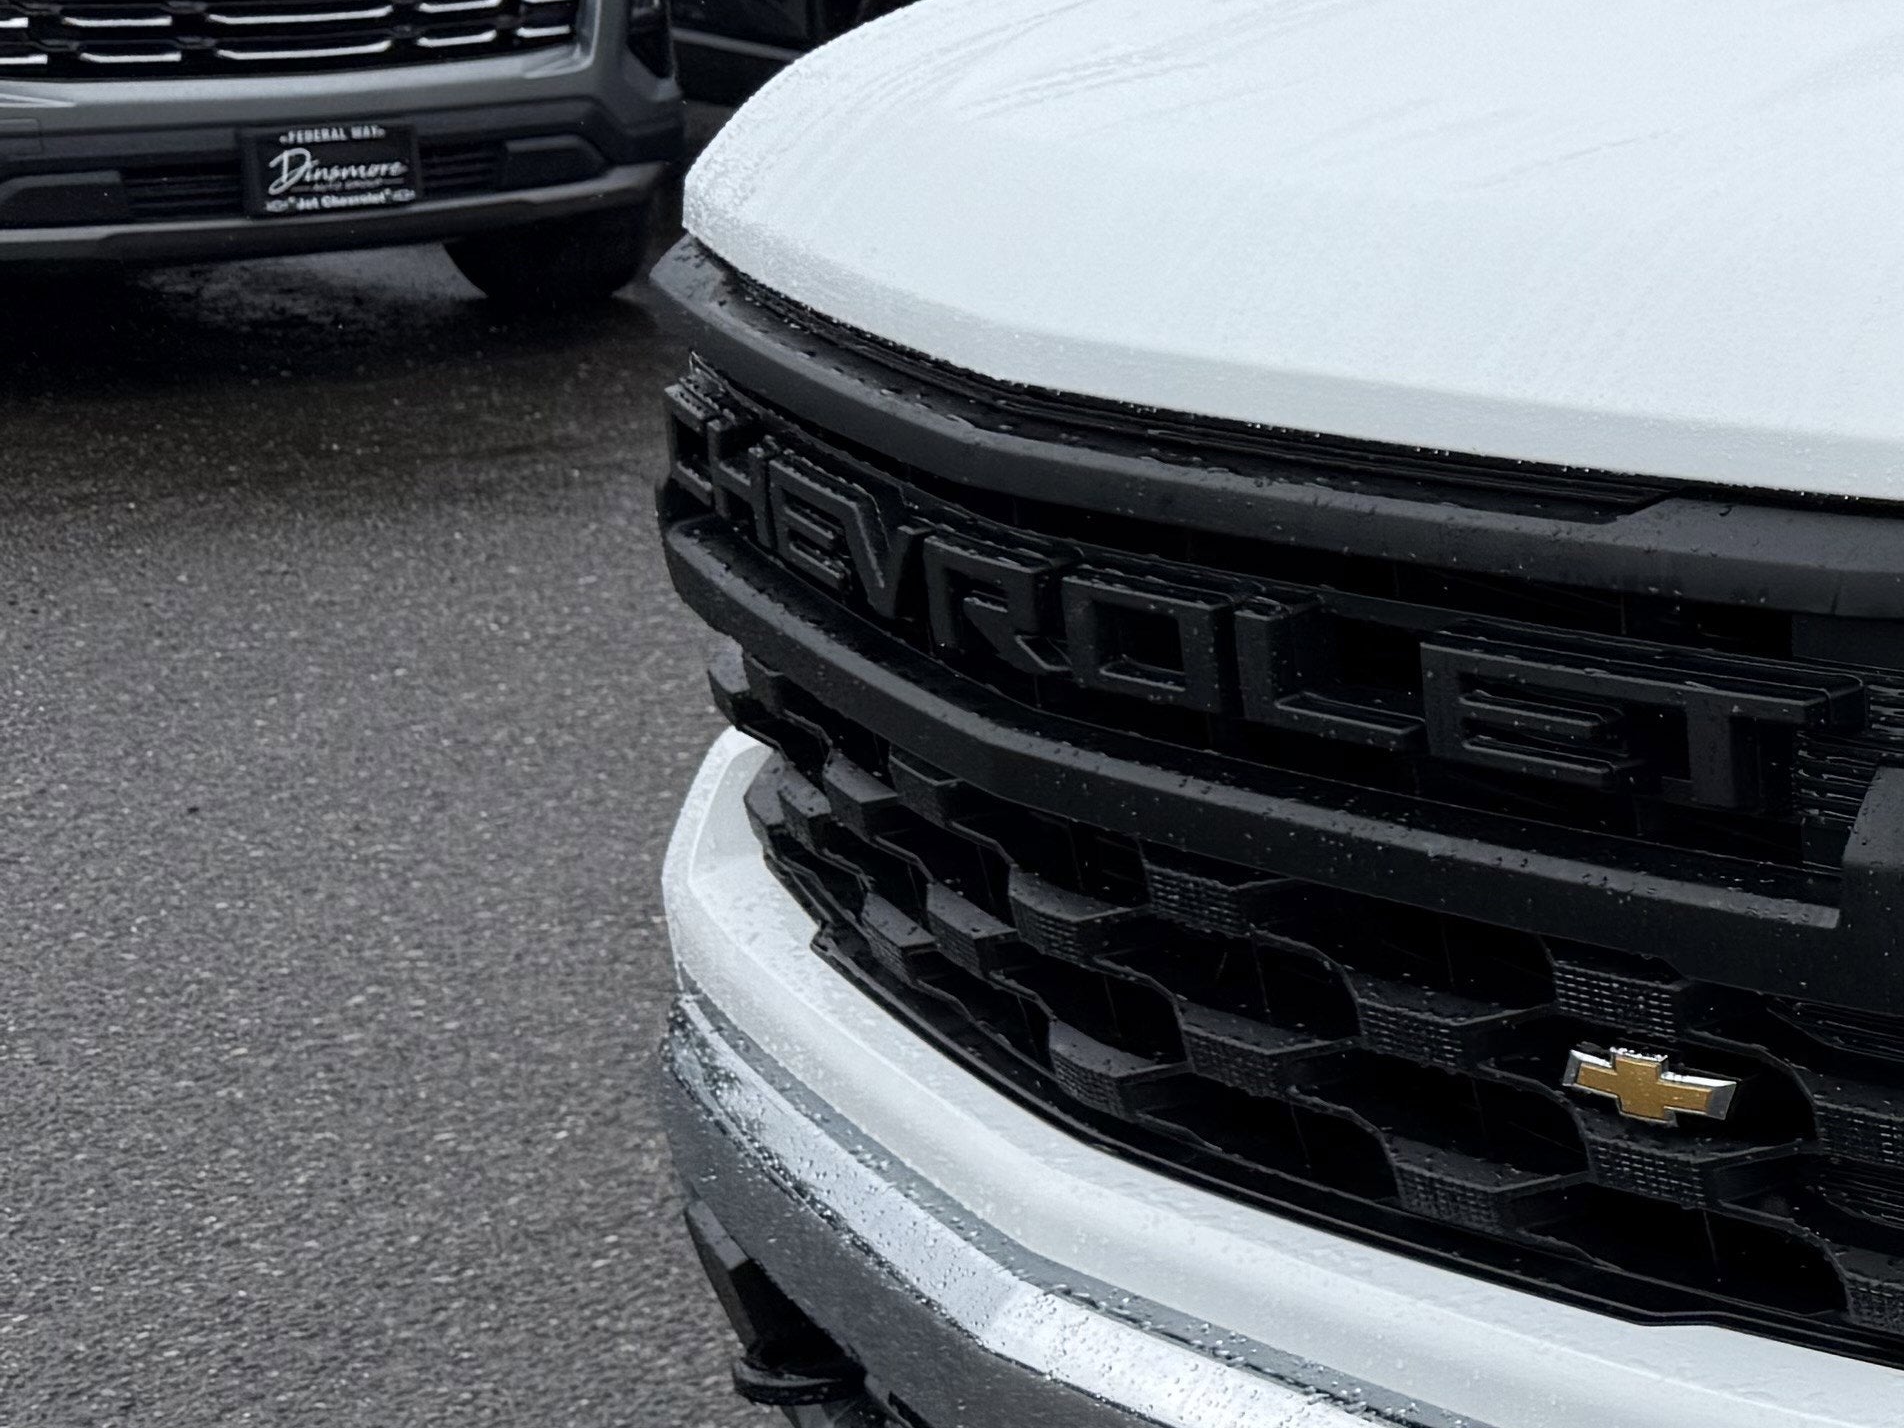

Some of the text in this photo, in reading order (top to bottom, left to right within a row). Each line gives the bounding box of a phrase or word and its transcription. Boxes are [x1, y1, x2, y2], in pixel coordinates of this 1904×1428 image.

[287, 127, 348, 144] FEDERAL
[268, 147, 408, 196] Dinsmore
[663, 378, 1855, 810] CHEVROLET
